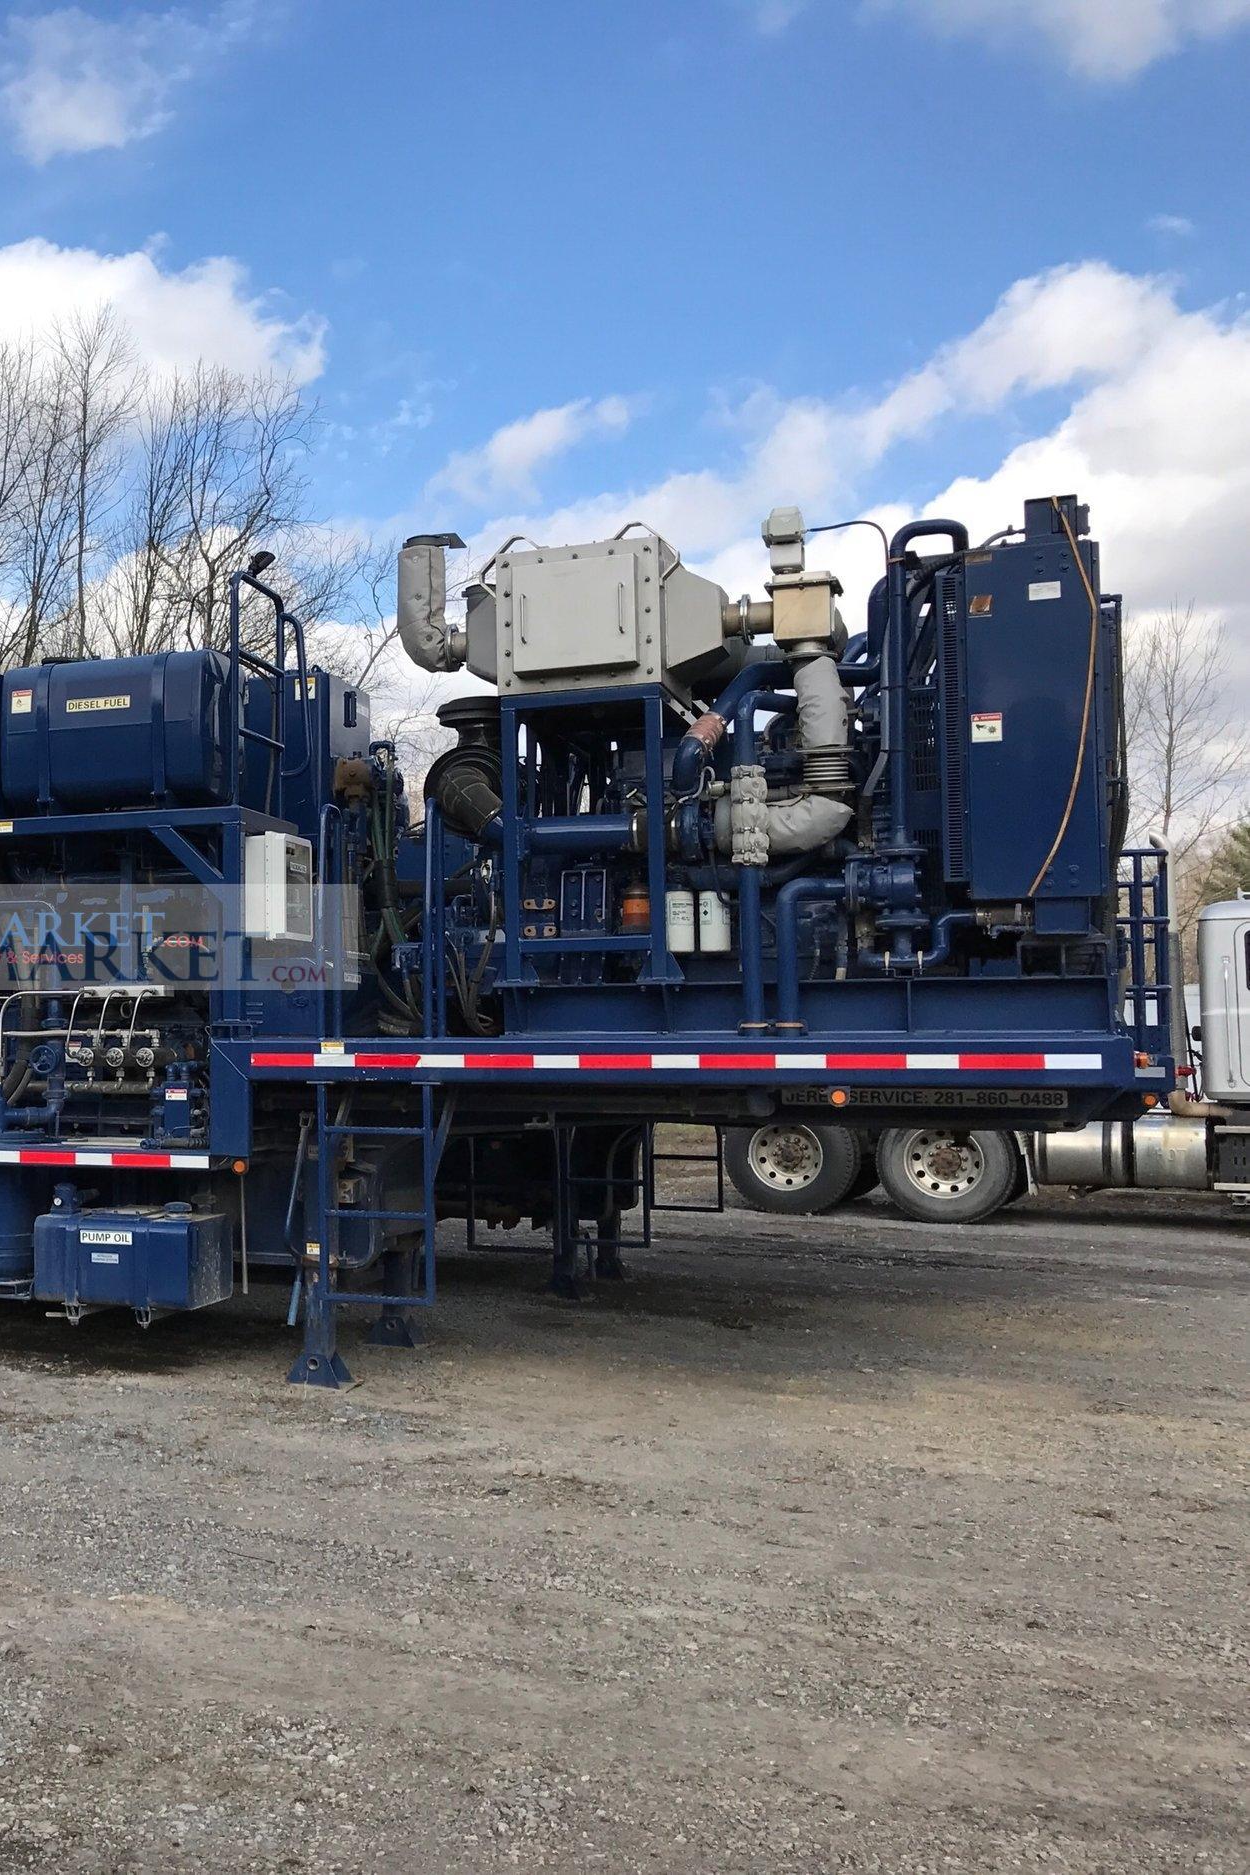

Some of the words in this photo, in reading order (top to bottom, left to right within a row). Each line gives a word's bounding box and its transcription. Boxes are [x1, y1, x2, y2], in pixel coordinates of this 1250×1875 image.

[68, 700, 101, 711] DIESEL
[103, 697, 128, 709] FUEL
[933, 1091, 1064, 1106] 281-860-0488
[81, 1232, 111, 1242] PUMP
[113, 1233, 130, 1243] OIL
